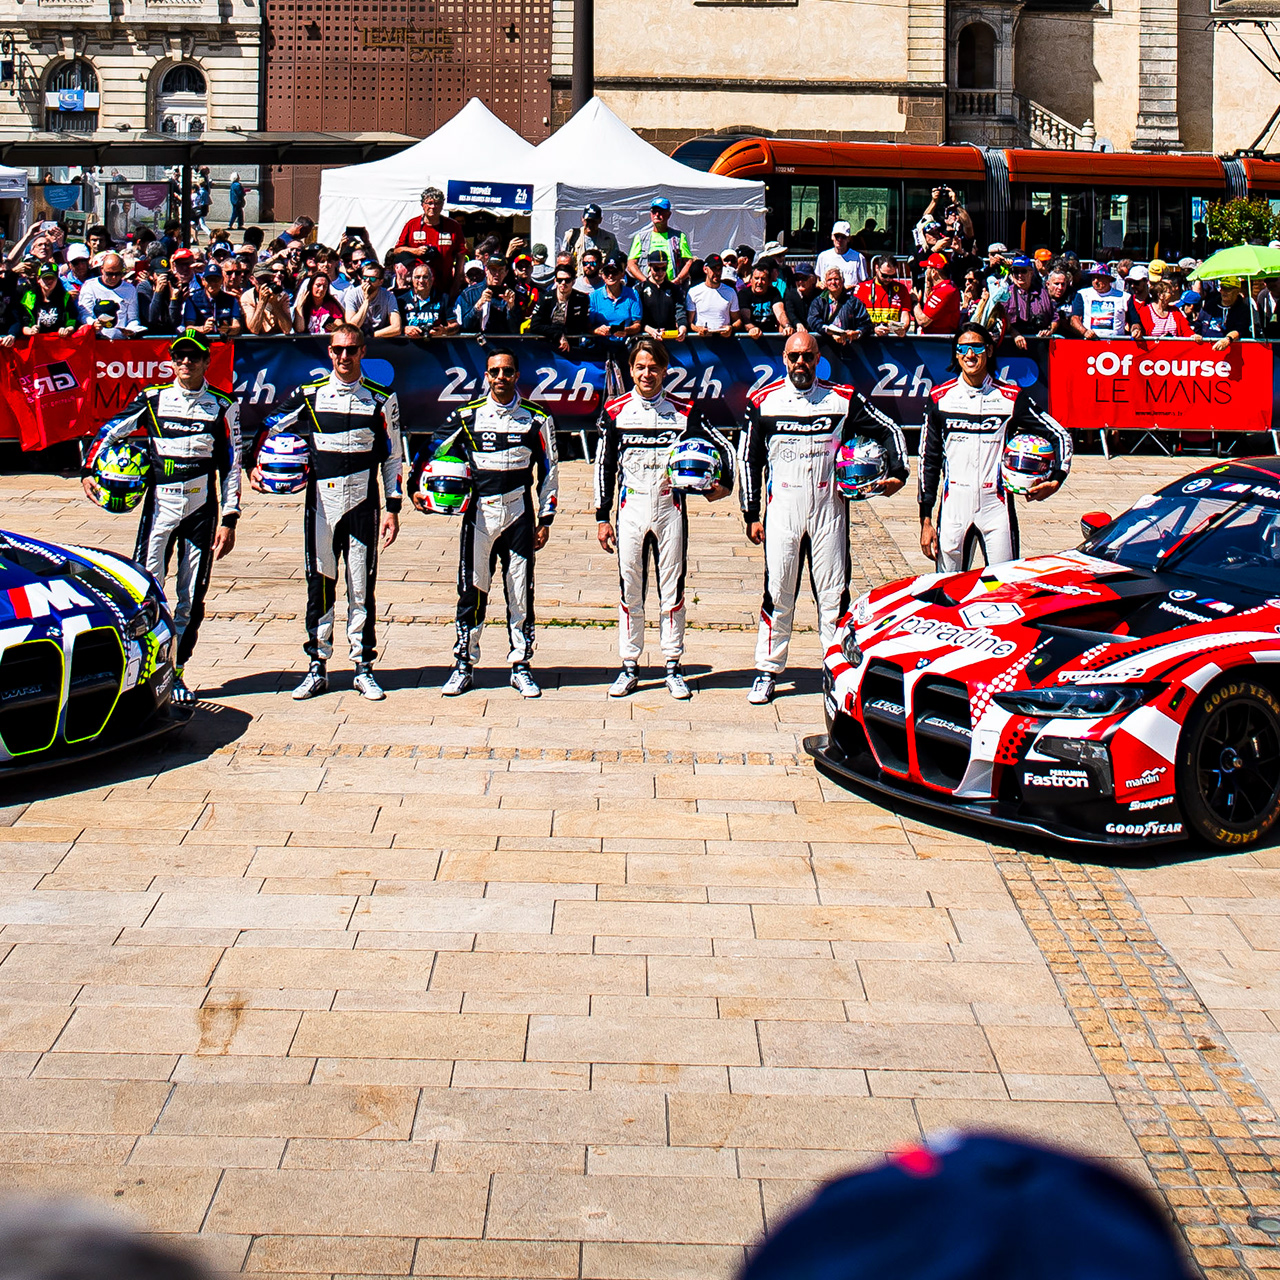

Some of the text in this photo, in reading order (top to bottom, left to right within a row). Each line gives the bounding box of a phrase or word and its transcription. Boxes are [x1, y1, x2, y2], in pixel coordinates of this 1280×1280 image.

[60, 93, 82, 103] LCL
[96, 360, 174, 379] cours
[1138, 358, 1233, 378] course
[437, 365, 488, 402] 24
[527, 365, 596, 402] 24h
[870, 362, 933, 398] 24h
[1095, 378, 1233, 405] LE MANS
[775, 421, 823, 432] TURBO
[945, 420, 993, 430] TURBO
[621, 434, 669, 445] TURBO
[23, 578, 96, 618] M
[1158, 601, 1213, 623] Motorsport
[898, 616, 1014, 656] paradine
[1203, 682, 1280, 714] GOODYEAR
[1023, 772, 1089, 788] Fastron
[1049, 769, 1088, 778] PERTAMINA
[1128, 795, 1175, 812] Snap-on
[1105, 821, 1183, 837] GOODYEAR
[1216, 828, 1259, 845] EAGLE
